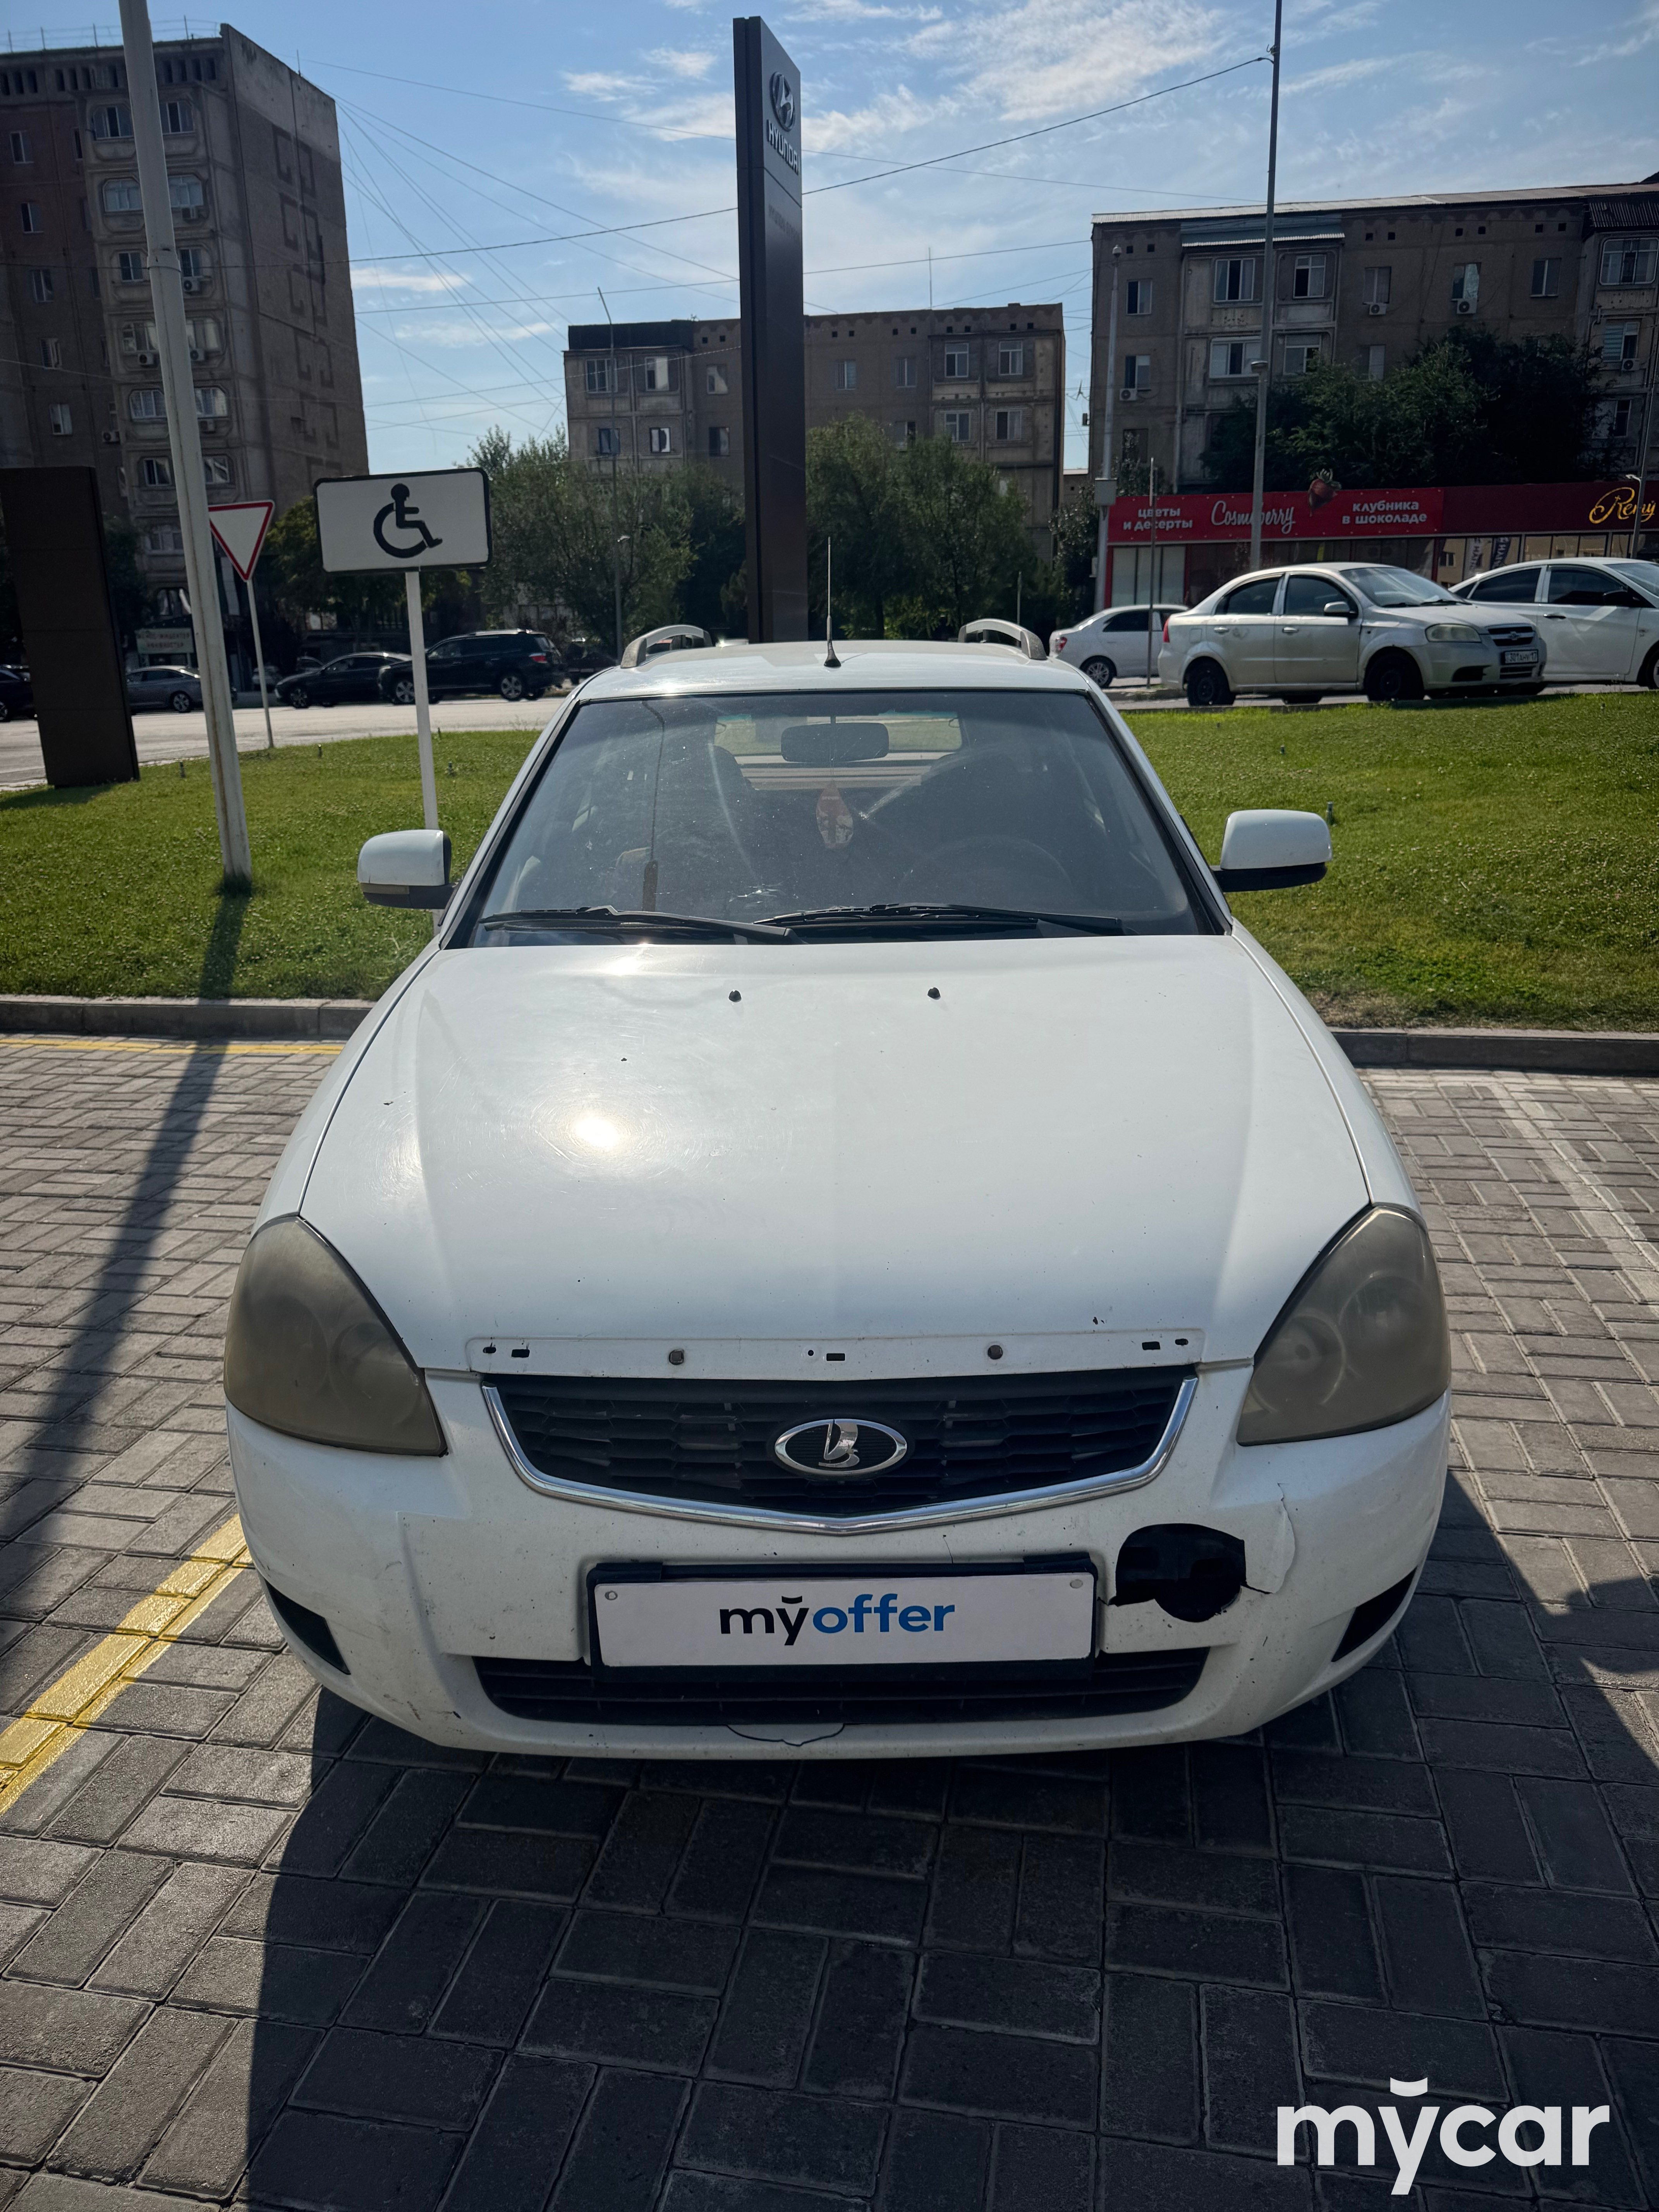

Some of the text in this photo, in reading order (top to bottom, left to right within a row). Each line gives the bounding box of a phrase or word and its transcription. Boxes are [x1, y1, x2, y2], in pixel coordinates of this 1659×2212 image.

[767, 119, 800, 175] HYUNDAI
[1352, 500, 1419, 513] клубника
[1137, 508, 1181, 519] цветы
[1211, 500, 1296, 534] Cosmerry
[1342, 513, 1427, 524] в шоколаде
[1123, 521, 1132, 530] и
